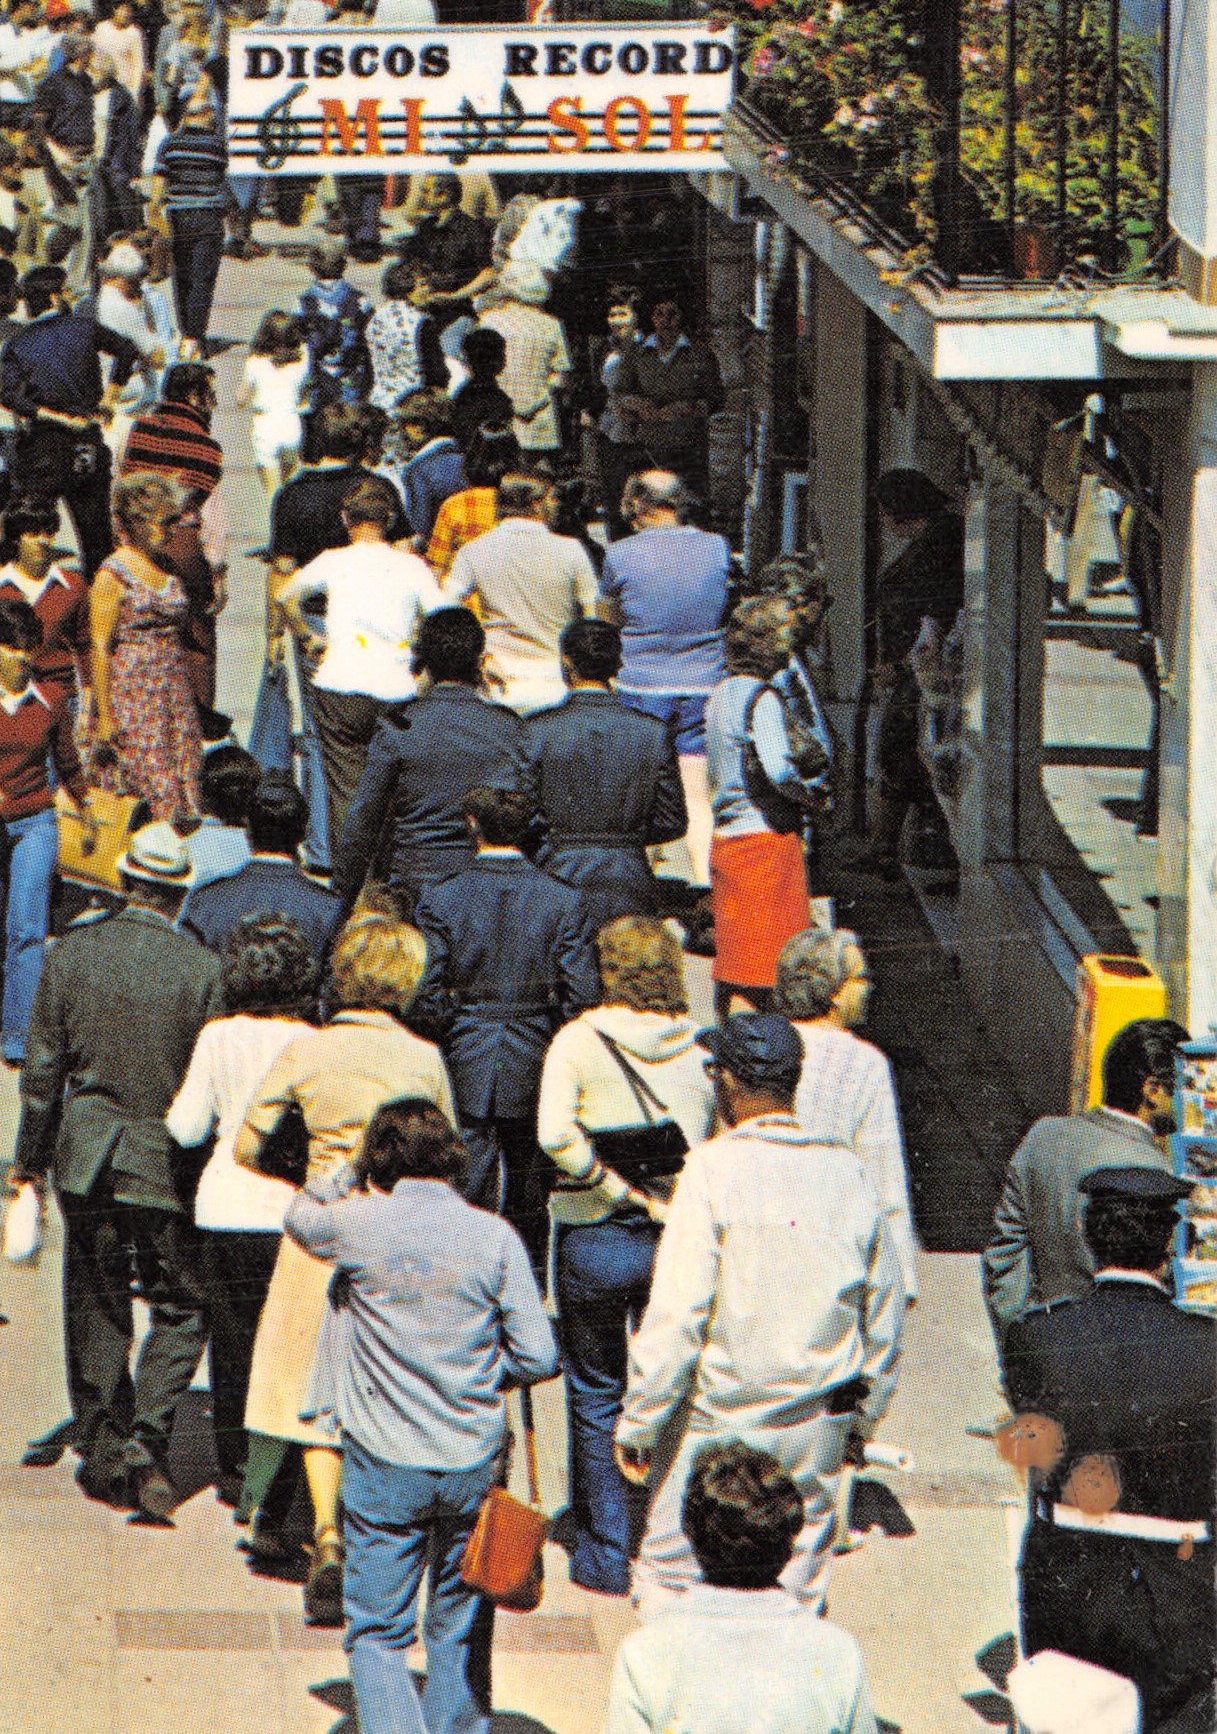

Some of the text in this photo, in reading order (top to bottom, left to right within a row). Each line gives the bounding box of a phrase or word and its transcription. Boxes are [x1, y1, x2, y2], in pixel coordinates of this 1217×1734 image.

[242, 39, 734, 80] DISCOS RECORD
[317, 93, 712, 158] MI SOL
